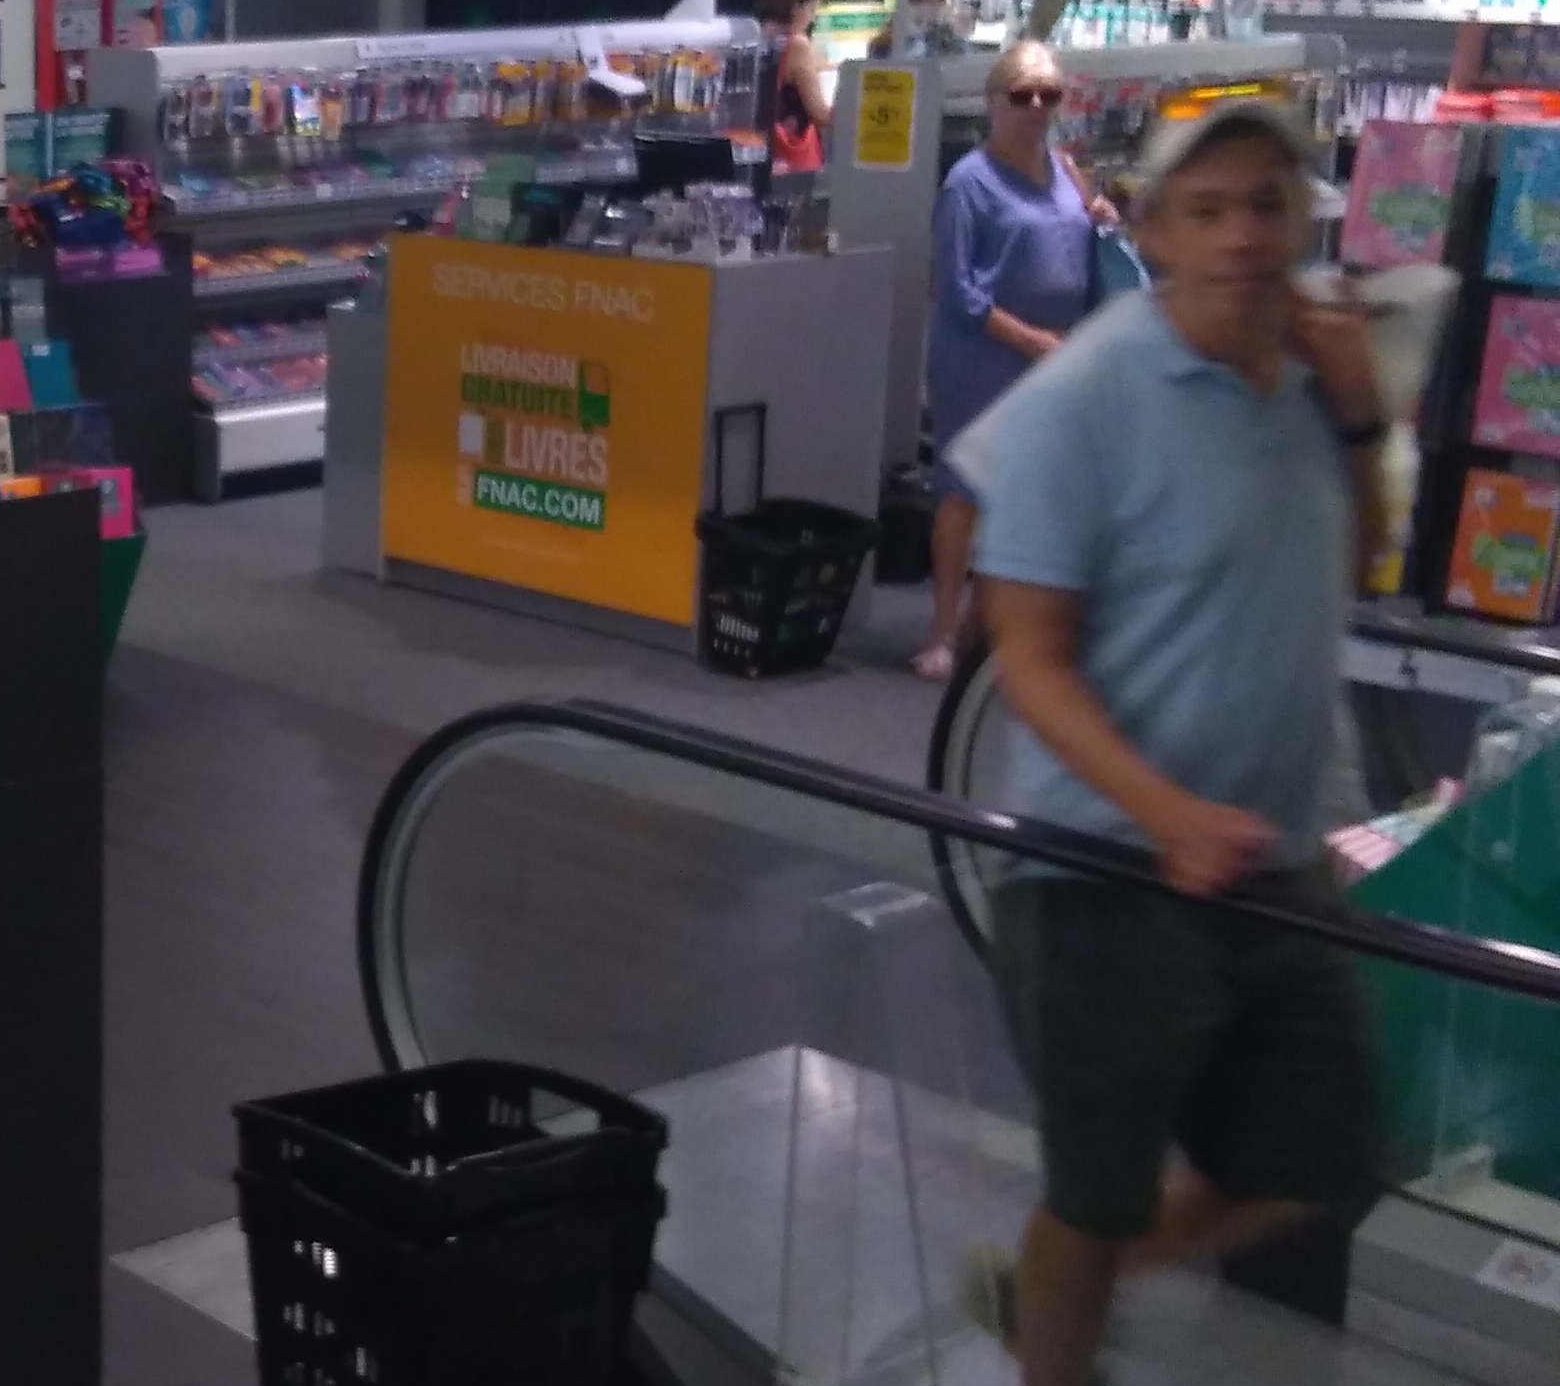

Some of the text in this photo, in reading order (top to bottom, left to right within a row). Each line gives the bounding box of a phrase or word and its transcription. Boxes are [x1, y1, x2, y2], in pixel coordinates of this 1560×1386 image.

[433, 262, 655, 323] SERVICES FNAC
[461, 344, 577, 390] LIVRAISON
[460, 371, 574, 422] GRATUITE
[504, 419, 608, 486] LIVRES
[476, 473, 602, 525] FNAC.COM
